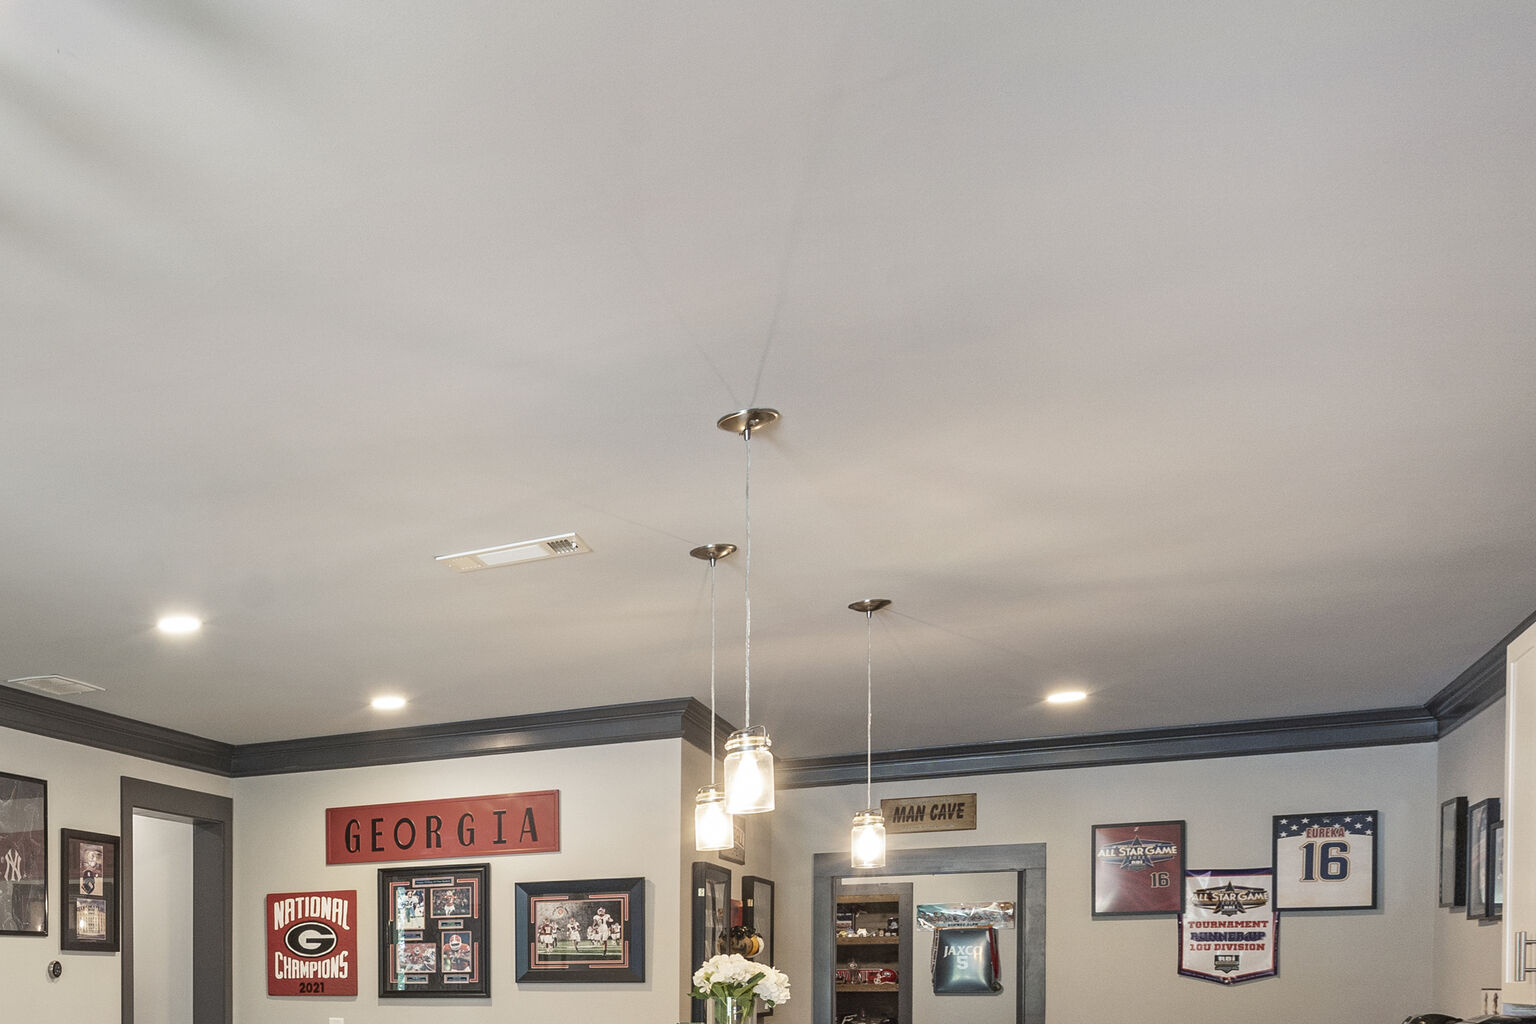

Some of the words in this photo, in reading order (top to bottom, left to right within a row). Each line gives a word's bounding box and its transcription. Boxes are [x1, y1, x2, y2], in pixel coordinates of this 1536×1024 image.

[892, 805, 926, 823] MAN
[929, 802, 966, 821] CAVE
[345, 807, 539, 853] GEORGIA
[1305, 827, 1345, 838] EUREKA
[1097, 848, 1116, 857] ALL
[1118, 847, 1144, 856] STAR
[1145, 846, 1178, 855] GAME
[1299, 840, 1351, 882] 16
[1150, 871, 1171, 888] 16
[1191, 892, 1210, 901] ALL
[1212, 891, 1236, 901] STAR
[1237, 892, 1269, 901] GAME
[273, 896, 351, 930] NATIONAL
[1187, 920, 1269, 929] TOURNAMENT
[1214, 943, 1266, 951] DIVISION
[274, 950, 349, 979] CHAMPIONS
[299, 982, 324, 993] 2021
